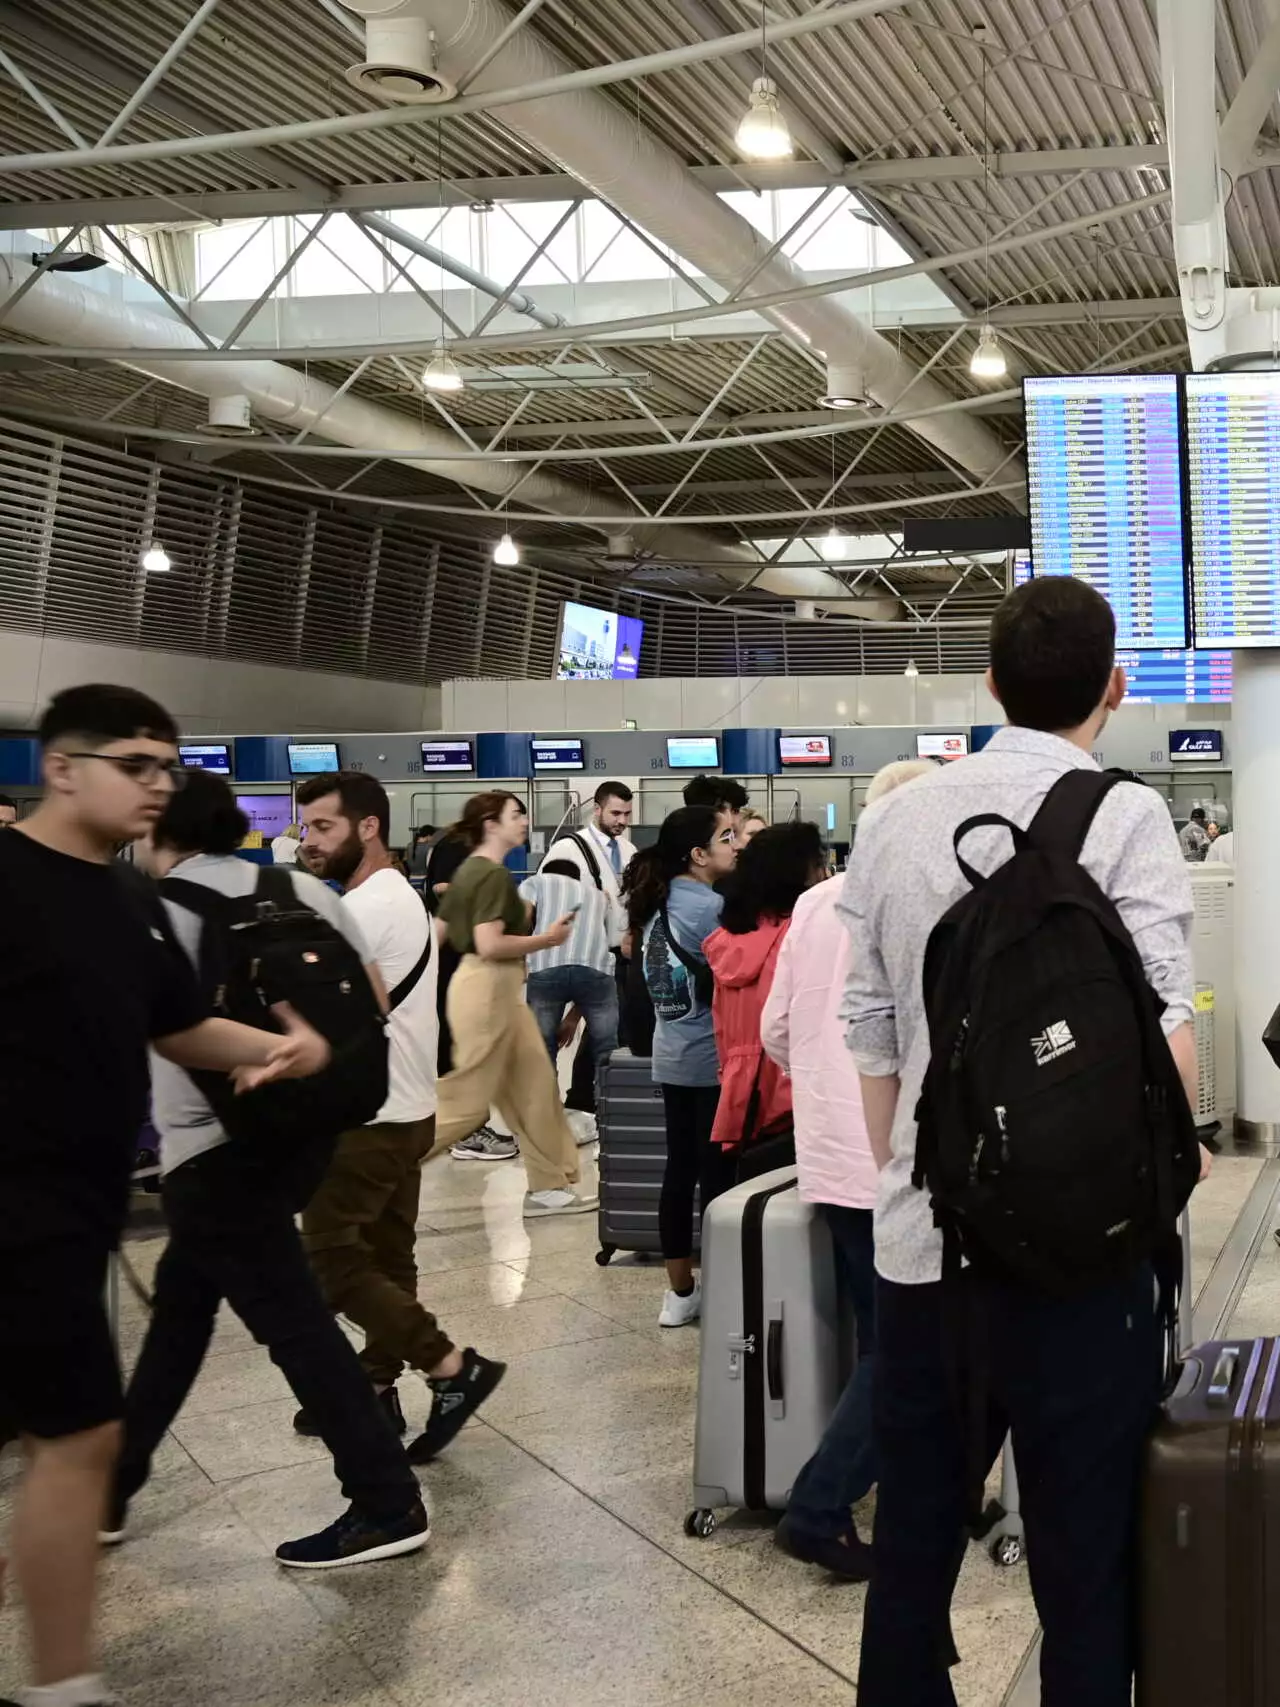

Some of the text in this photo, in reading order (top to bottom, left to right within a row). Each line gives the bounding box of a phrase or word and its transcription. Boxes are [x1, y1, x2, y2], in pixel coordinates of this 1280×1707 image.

[841, 755, 854, 767] 83
[1150, 750, 1163, 762] 80
[594, 758, 606, 770] 85
[651, 758, 663, 770] 84
